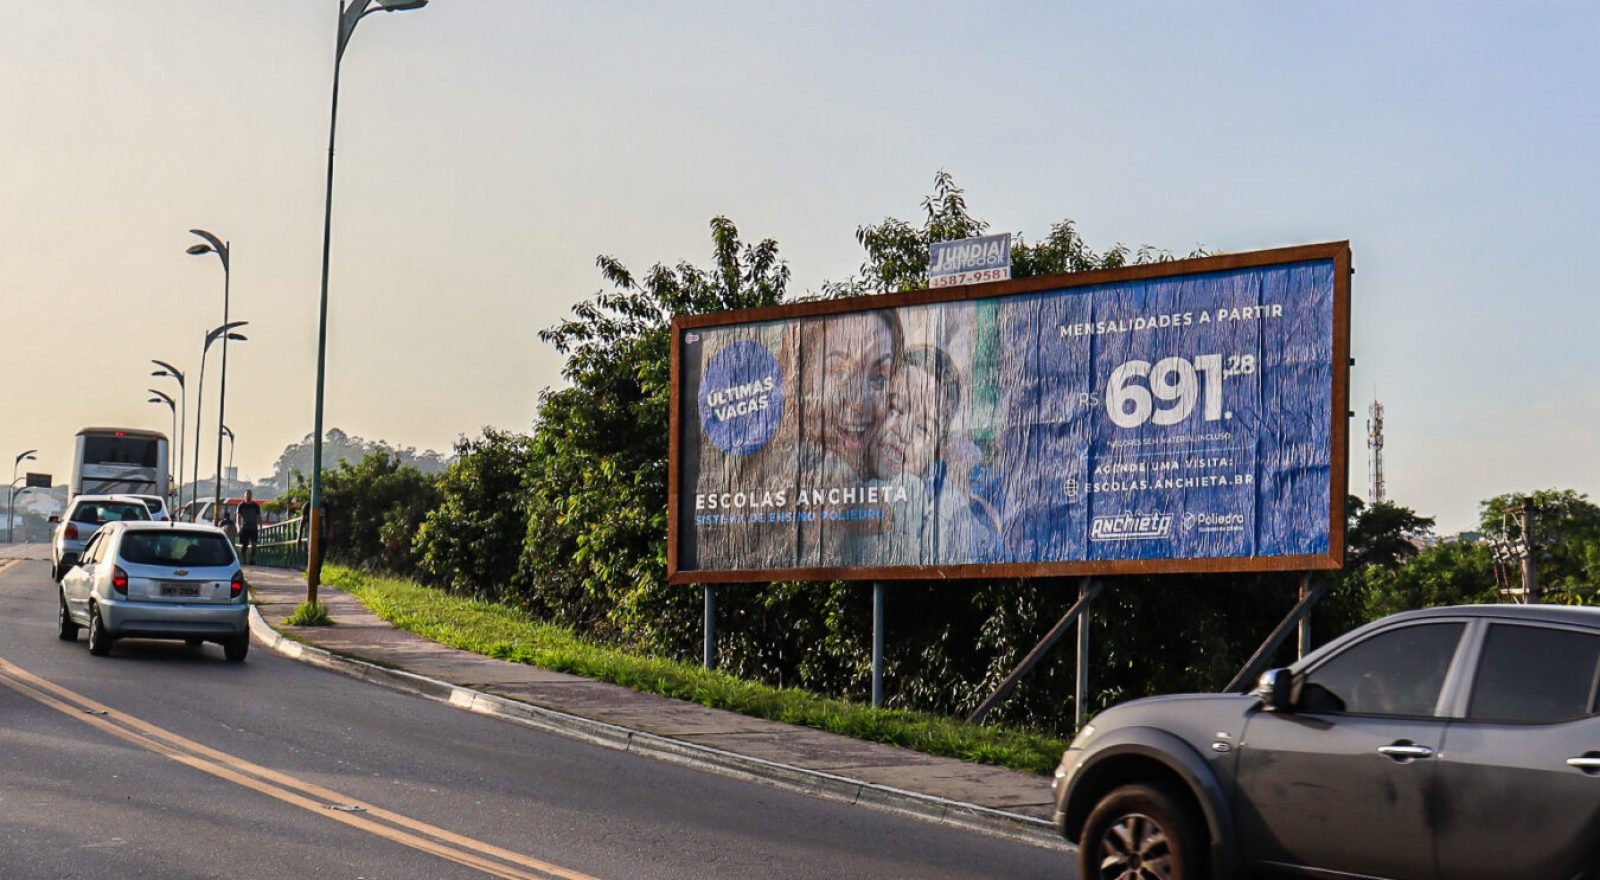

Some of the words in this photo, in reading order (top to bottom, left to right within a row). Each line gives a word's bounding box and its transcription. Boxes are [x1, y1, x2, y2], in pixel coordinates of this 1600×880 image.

[943, 255, 1004, 271] OUTDOOR
[1060, 312, 1192, 337] MENSALIDADES
[1199, 311, 1211, 324] A
[1218, 304, 1283, 322] PARTIR
[716, 395, 769, 421] VAGAS
[1152, 461, 1179, 471] UMA
[1085, 474, 1255, 493] ESCOLAS.ANCHIETA.BR
[696, 490, 787, 509] ESCOLAS
[797, 486, 908, 505] ANCHIETA
[1198, 511, 1244, 525] Poliedro
